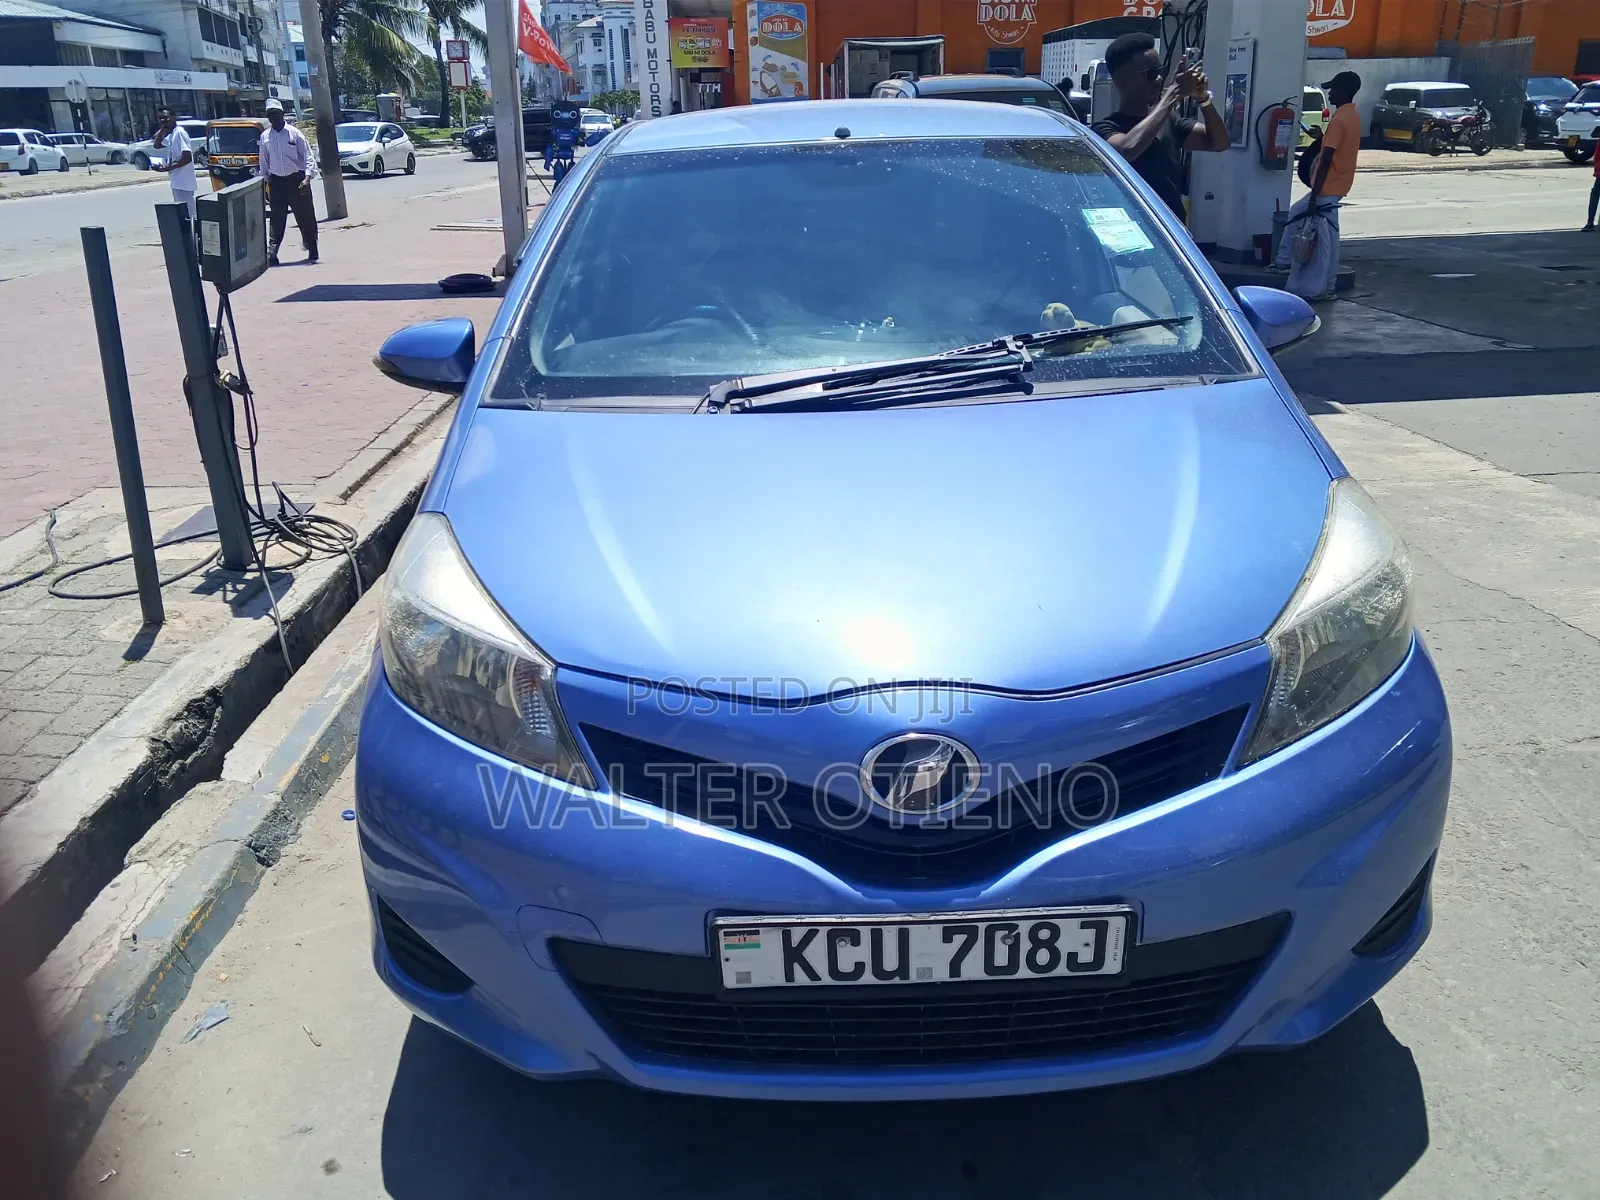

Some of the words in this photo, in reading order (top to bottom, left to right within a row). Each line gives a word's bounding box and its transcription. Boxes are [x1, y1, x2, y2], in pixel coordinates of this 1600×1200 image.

[523, 12, 539, 29] She
[643, 0, 656, 44] BABU
[762, 21, 803, 33] DOLA
[979, 4, 1033, 22] DOLA
[522, 22, 557, 52] V-Pow
[646, 48, 661, 118] MOTORS
[781, 927, 910, 983] KCU
[942, 919, 1109, 978] 708J
